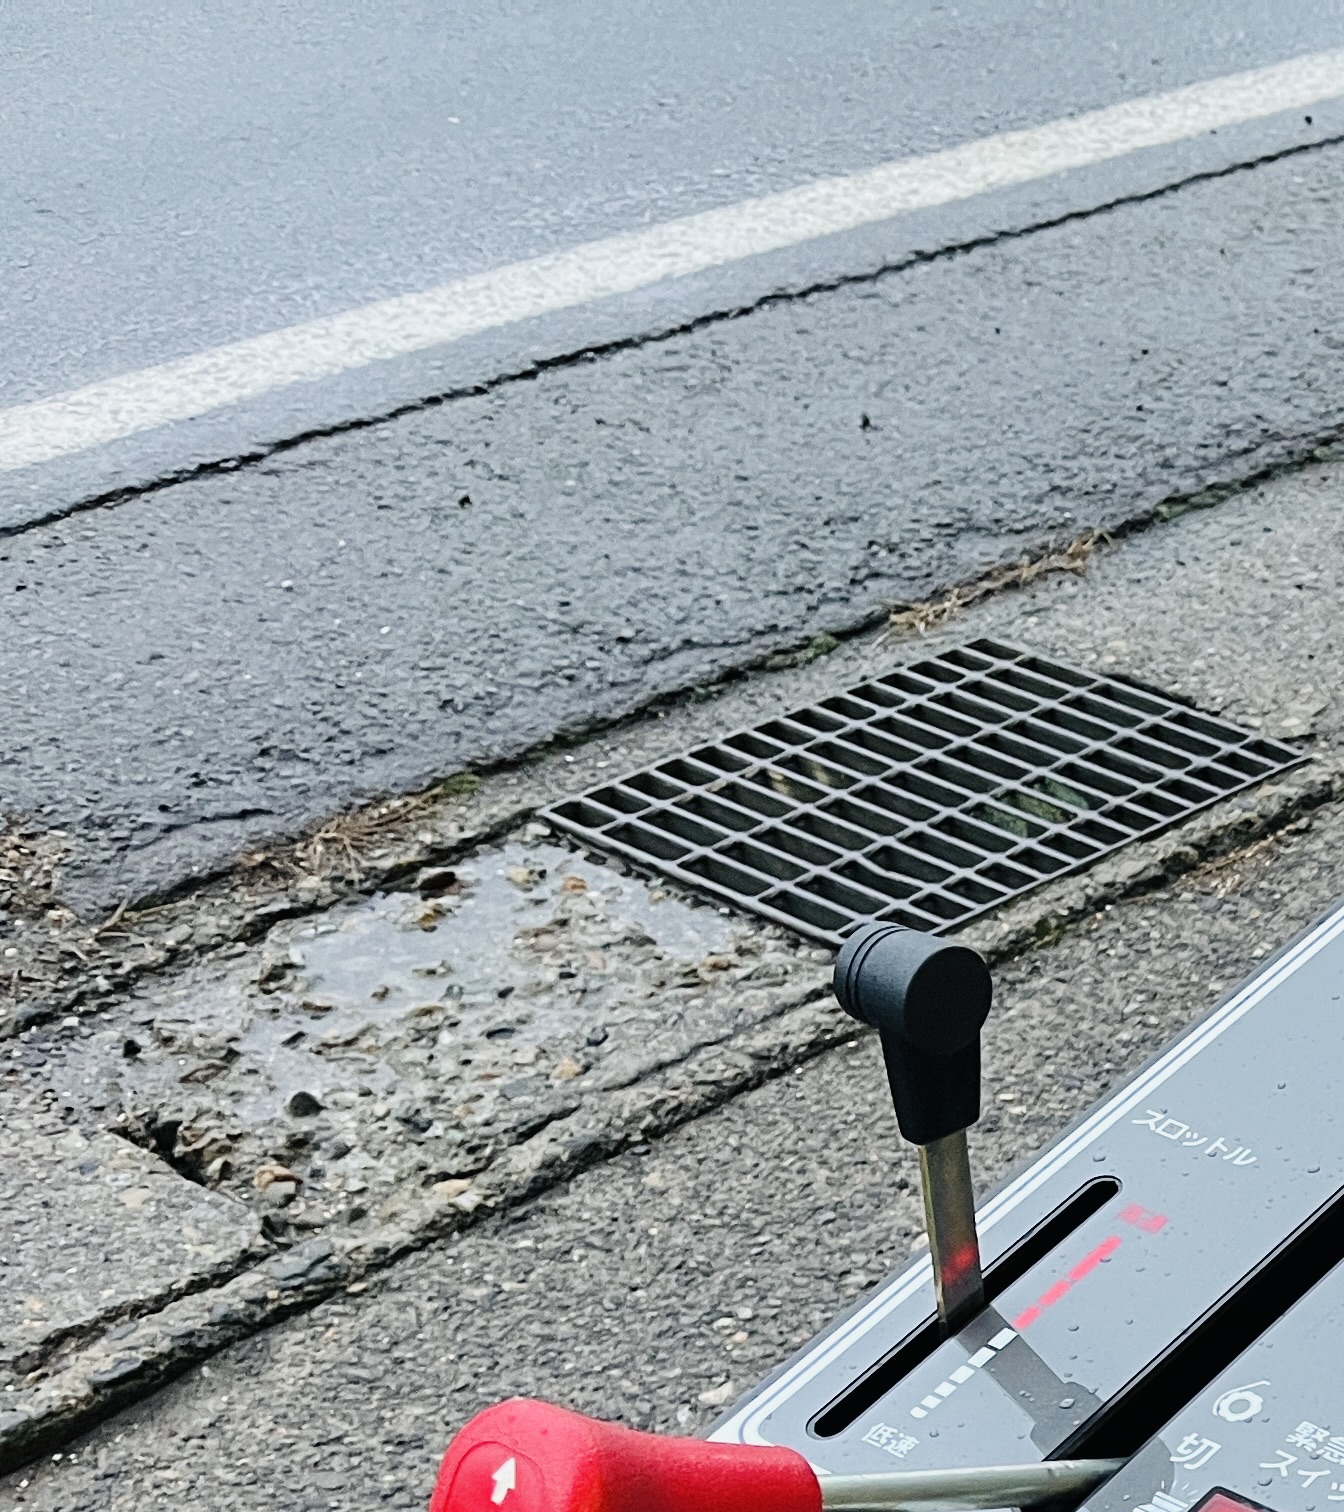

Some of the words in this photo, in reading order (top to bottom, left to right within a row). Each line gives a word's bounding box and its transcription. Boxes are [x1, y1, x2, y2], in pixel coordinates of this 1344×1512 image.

[1131, 1109, 1258, 1166] スロットル
[861, 1422, 920, 1459] 低速
[1169, 1432, 1221, 1470] 切
